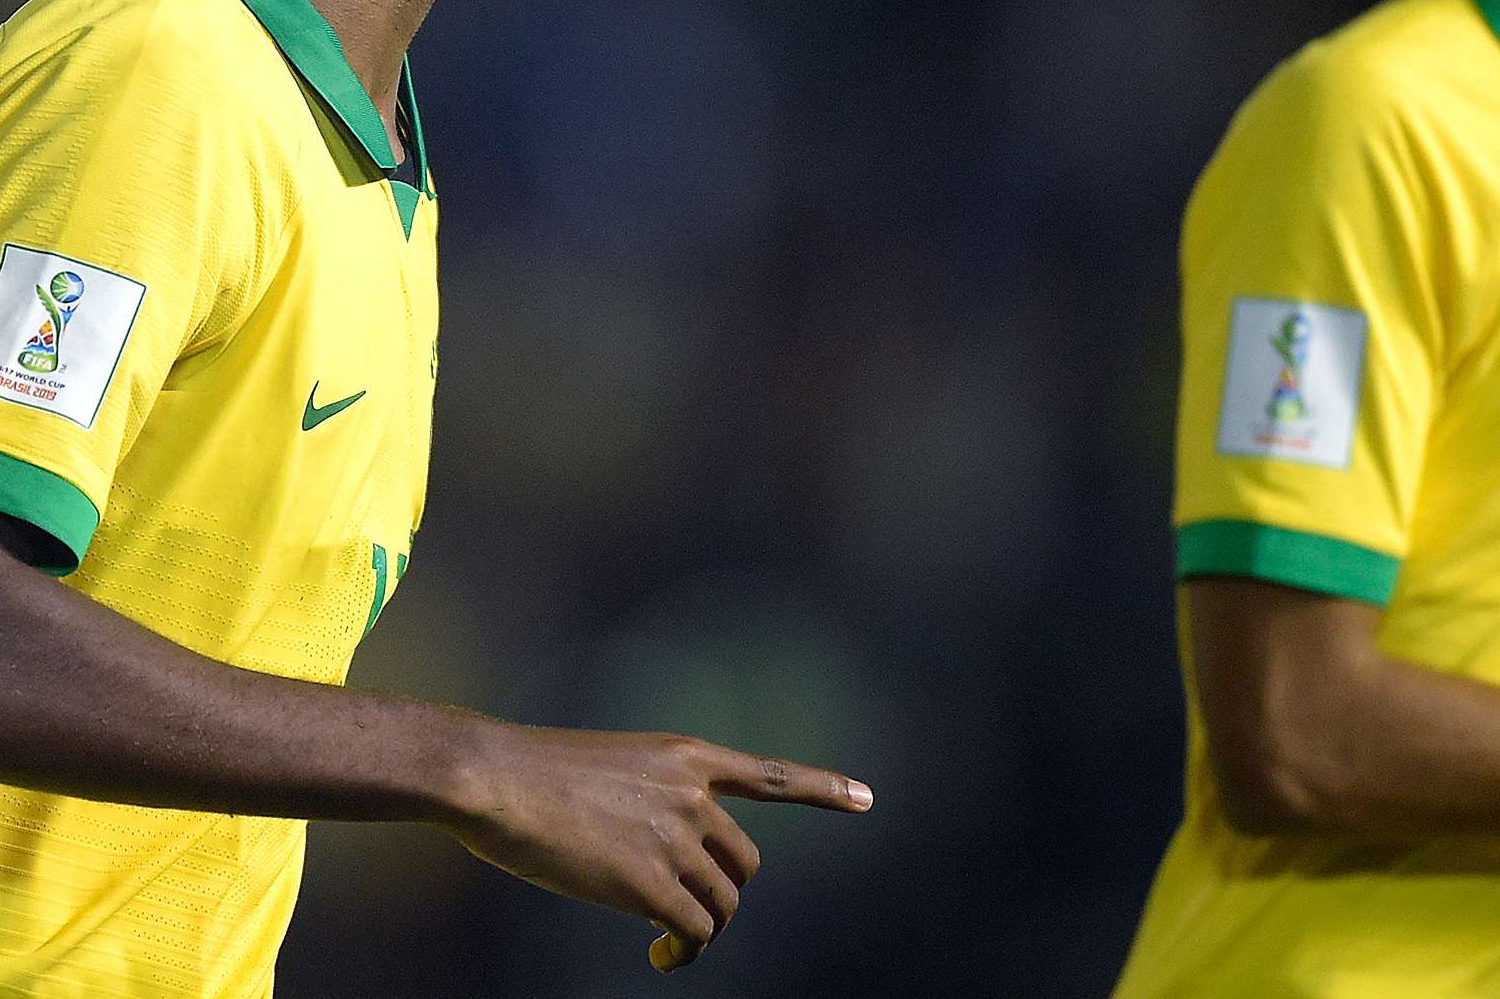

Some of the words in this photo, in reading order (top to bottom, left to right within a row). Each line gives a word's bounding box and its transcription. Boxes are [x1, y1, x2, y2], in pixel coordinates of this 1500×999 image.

[22, 353, 53, 371] FIFA
[15, 371, 46, 385] WORLD
[48, 380, 66, 389] CUP
[32, 387, 57, 401] 2019
